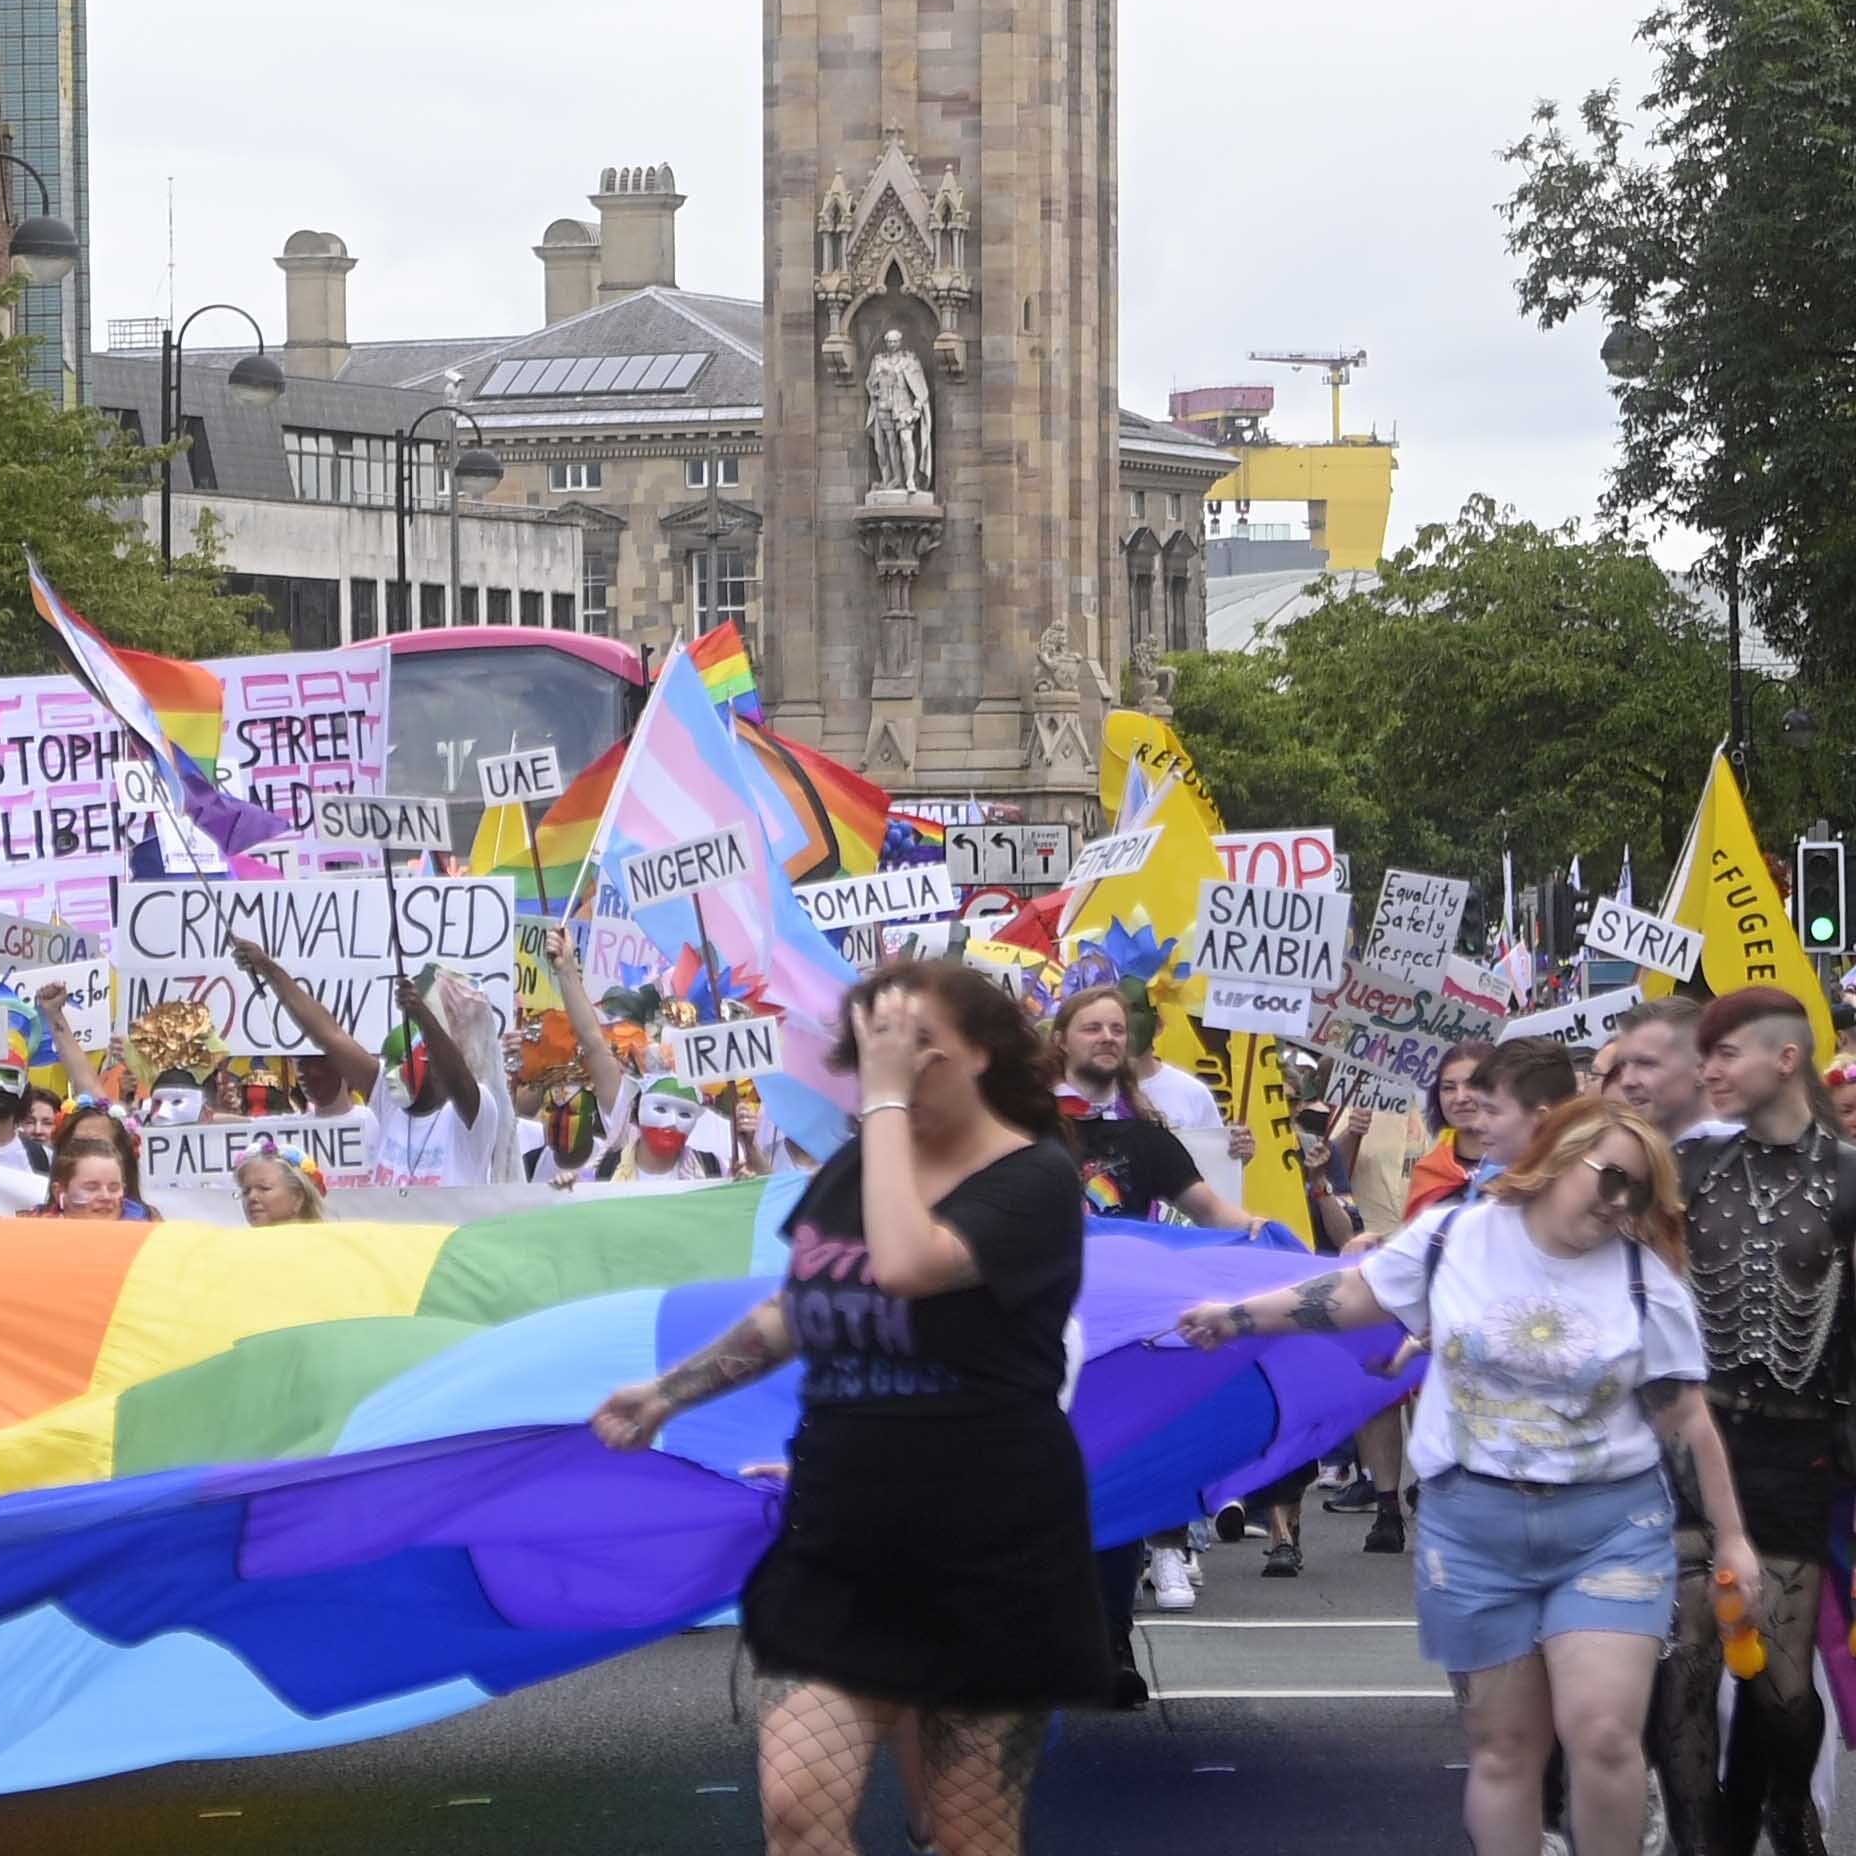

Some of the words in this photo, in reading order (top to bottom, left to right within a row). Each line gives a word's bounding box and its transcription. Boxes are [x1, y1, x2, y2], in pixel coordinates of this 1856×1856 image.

[237, 710, 366, 769] STREET
[125, 767, 232, 804] QAR
[486, 756, 554, 797] UAE
[322, 801, 441, 842] SUDAN
[630, 839, 746, 904] NIGERIA
[1069, 837, 1152, 882] ETHIOPIA
[1215, 837, 1333, 891] TOP
[129, 884, 510, 959] CRIMINALISED
[1209, 885, 1324, 935] SAUDI
[1712, 848, 1777, 981] FUGEE
[1196, 929, 1333, 982] ARABIA
[1366, 929, 1448, 969] Respect
[1597, 910, 1689, 973] SYRIA
[129, 977, 167, 1040] IN
[174, 976, 237, 1042] 70
[1253, 994, 1302, 1014] GOLF
[1311, 962, 1412, 1019] Queer
[684, 1026, 775, 1077] IRAN
[1352, 1080, 1409, 1114] future
